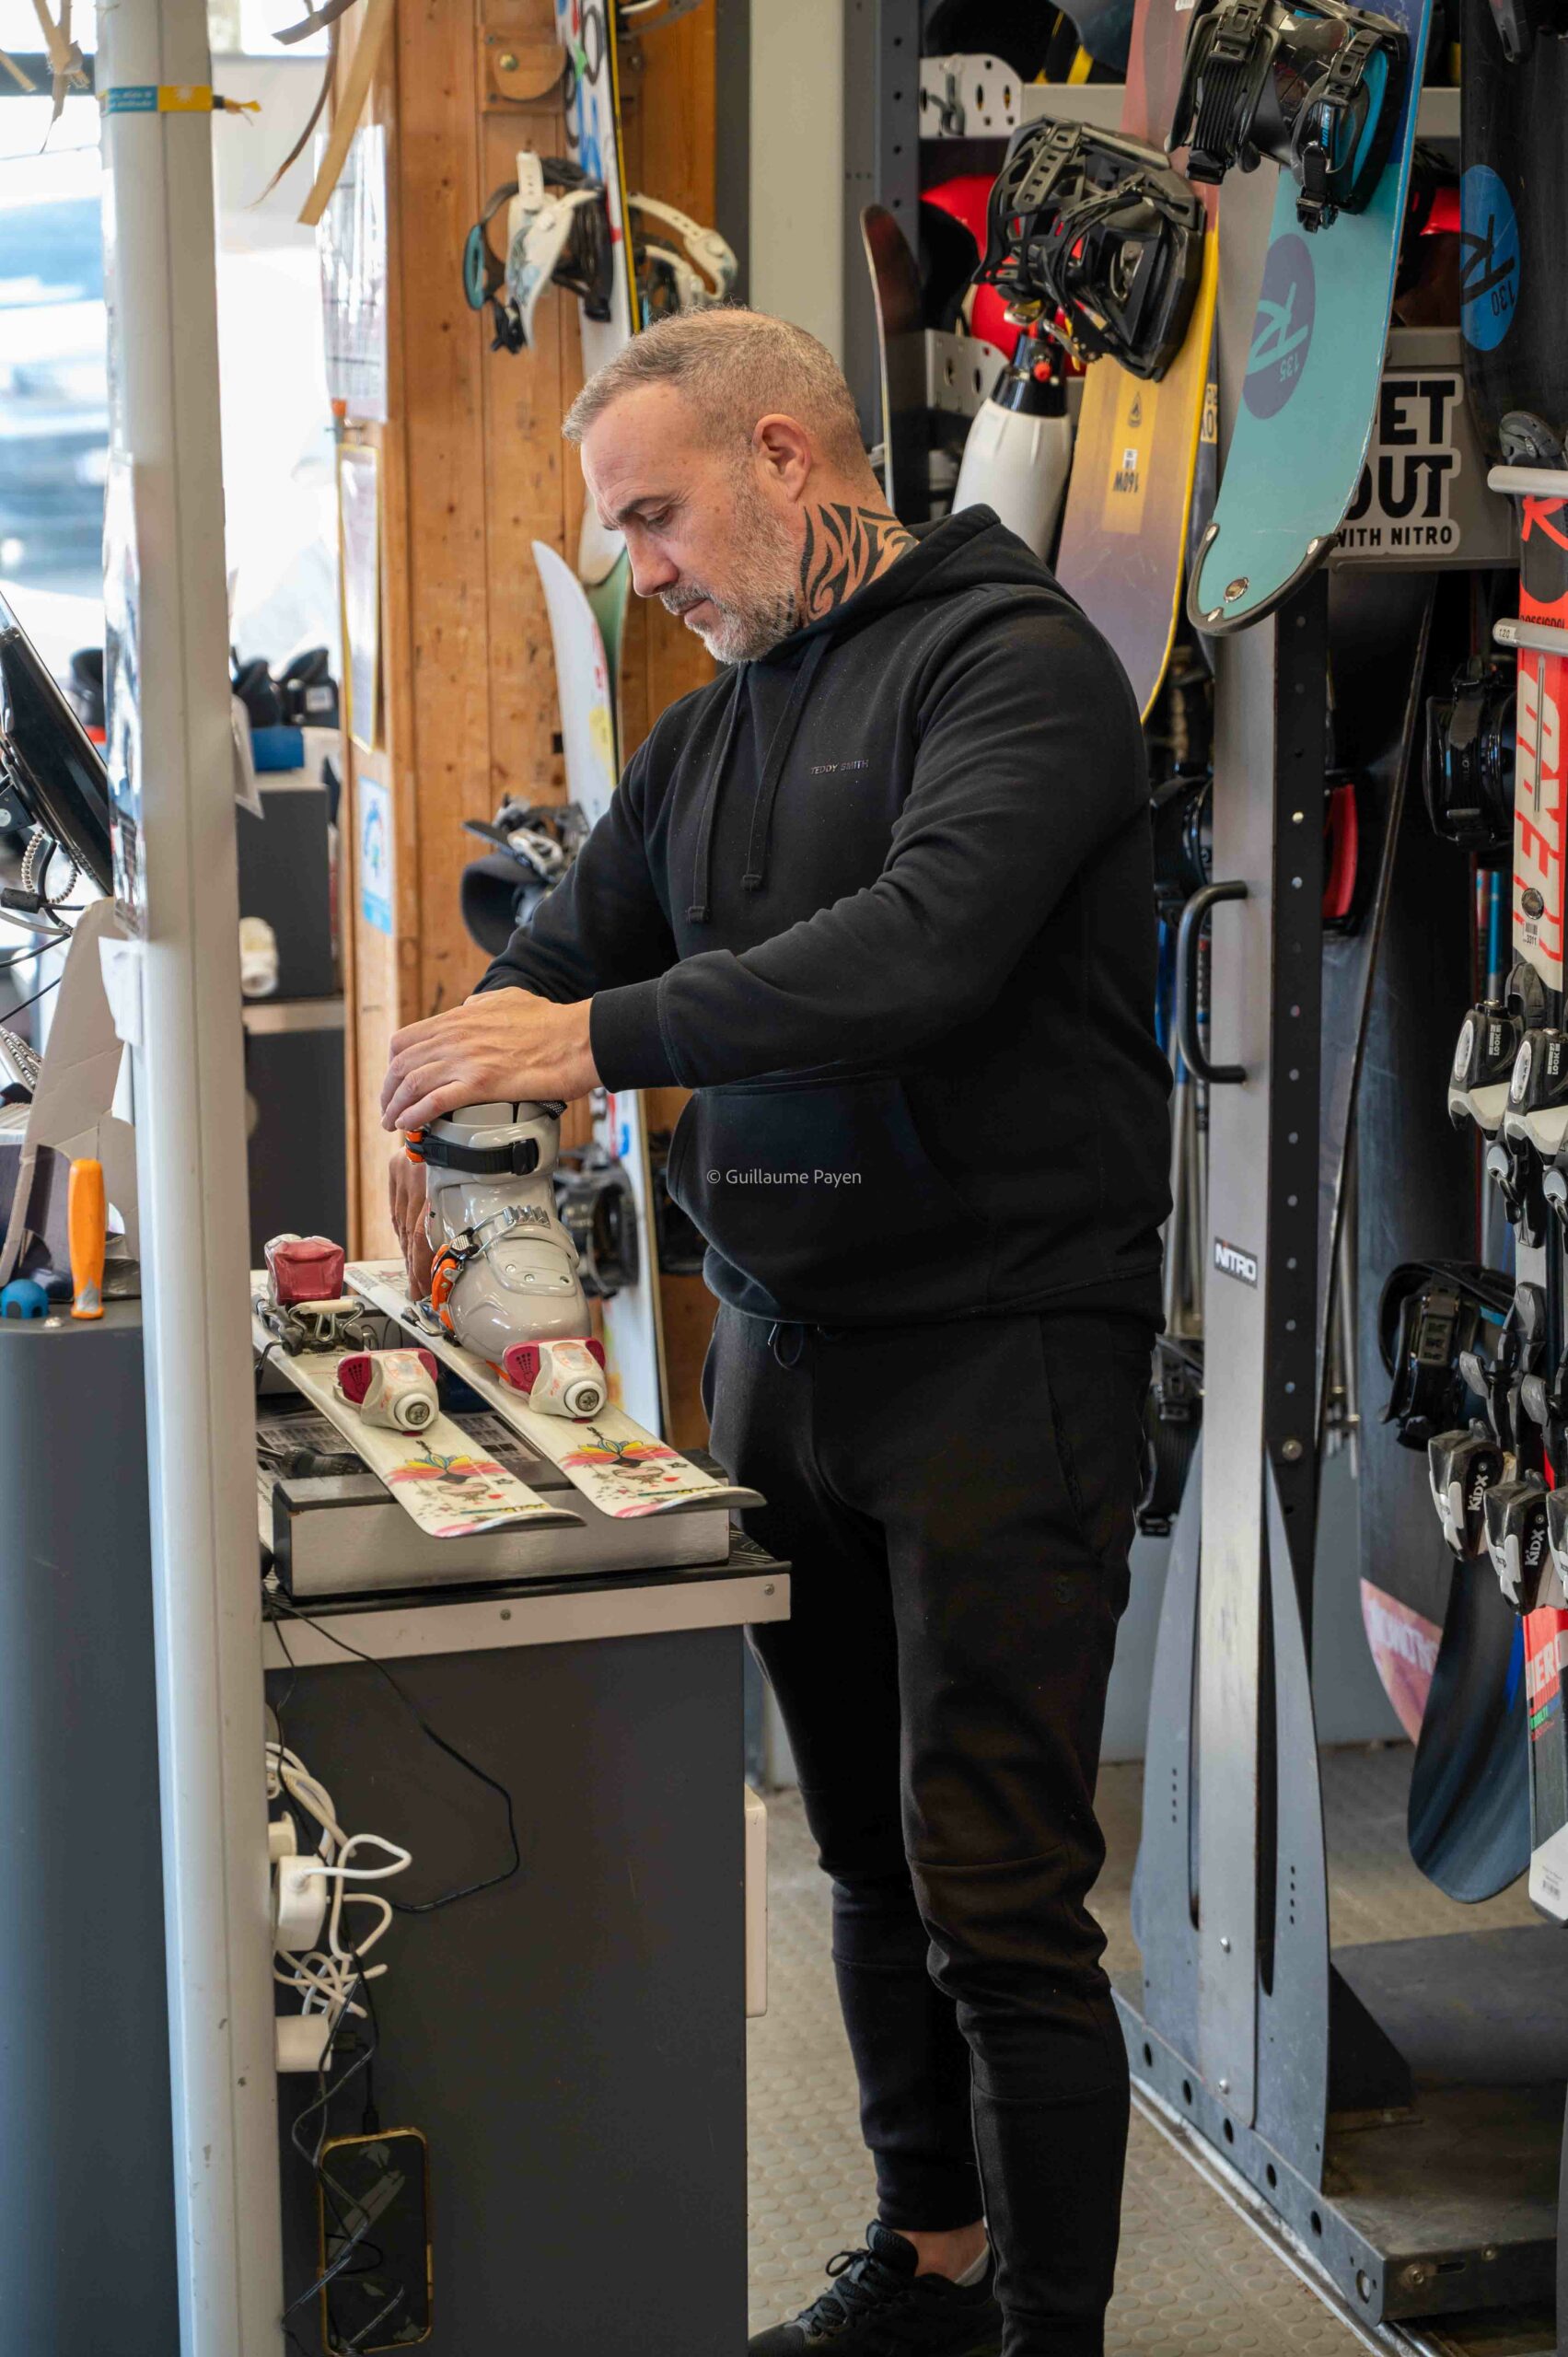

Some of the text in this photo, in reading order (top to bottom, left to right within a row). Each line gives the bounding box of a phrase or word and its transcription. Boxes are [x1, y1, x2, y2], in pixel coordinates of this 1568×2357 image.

[1378, 380, 1455, 446] ET
[1335, 526, 1452, 548] WITH NITRO
[811, 760, 869, 774] TEDDY SMITH
[1552, 1051, 1561, 1075] LOOK
[1215, 1240, 1257, 1282] NITRO
